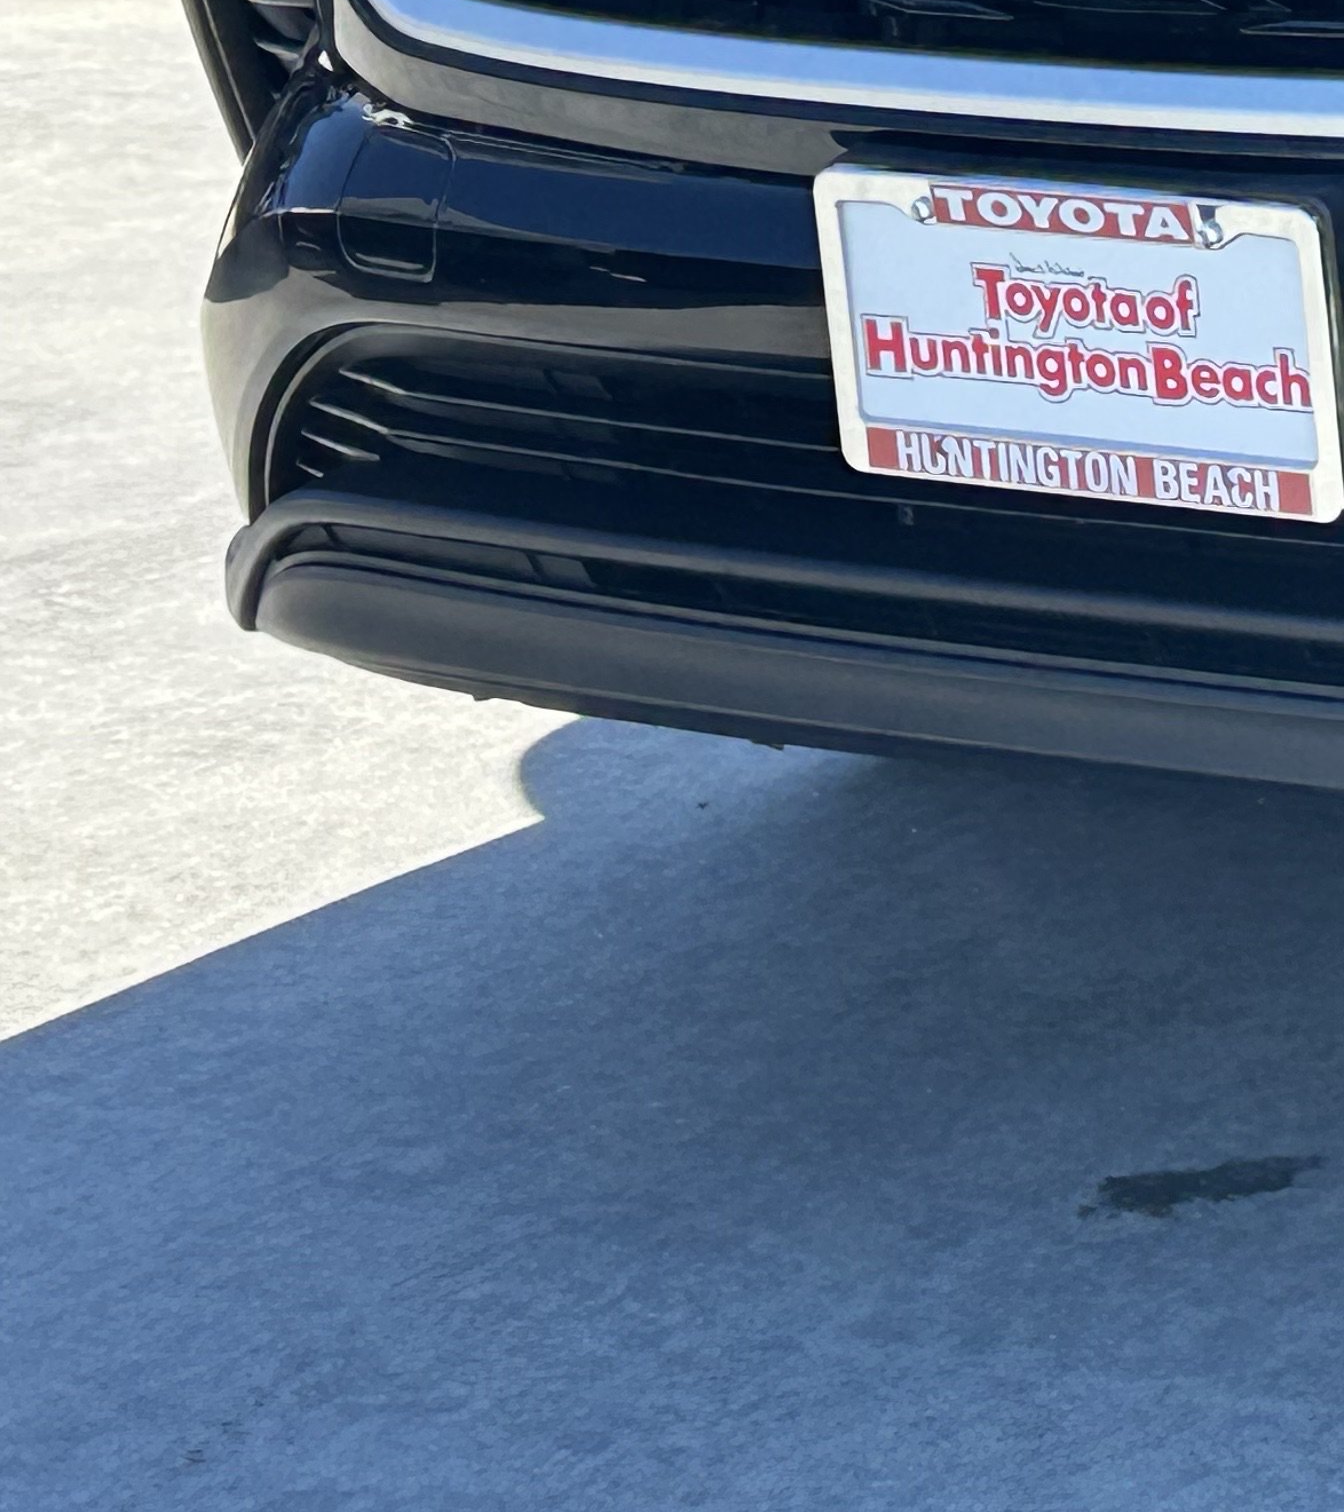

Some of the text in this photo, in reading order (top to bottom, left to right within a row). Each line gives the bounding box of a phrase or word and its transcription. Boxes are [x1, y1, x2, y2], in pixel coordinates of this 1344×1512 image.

[933, 188, 1191, 241] TOYOTA
[973, 267, 1194, 333] Toyota of
[865, 319, 1312, 408] Huntington Beach
[896, 430, 1280, 513] HUNTINGTON BEACH
